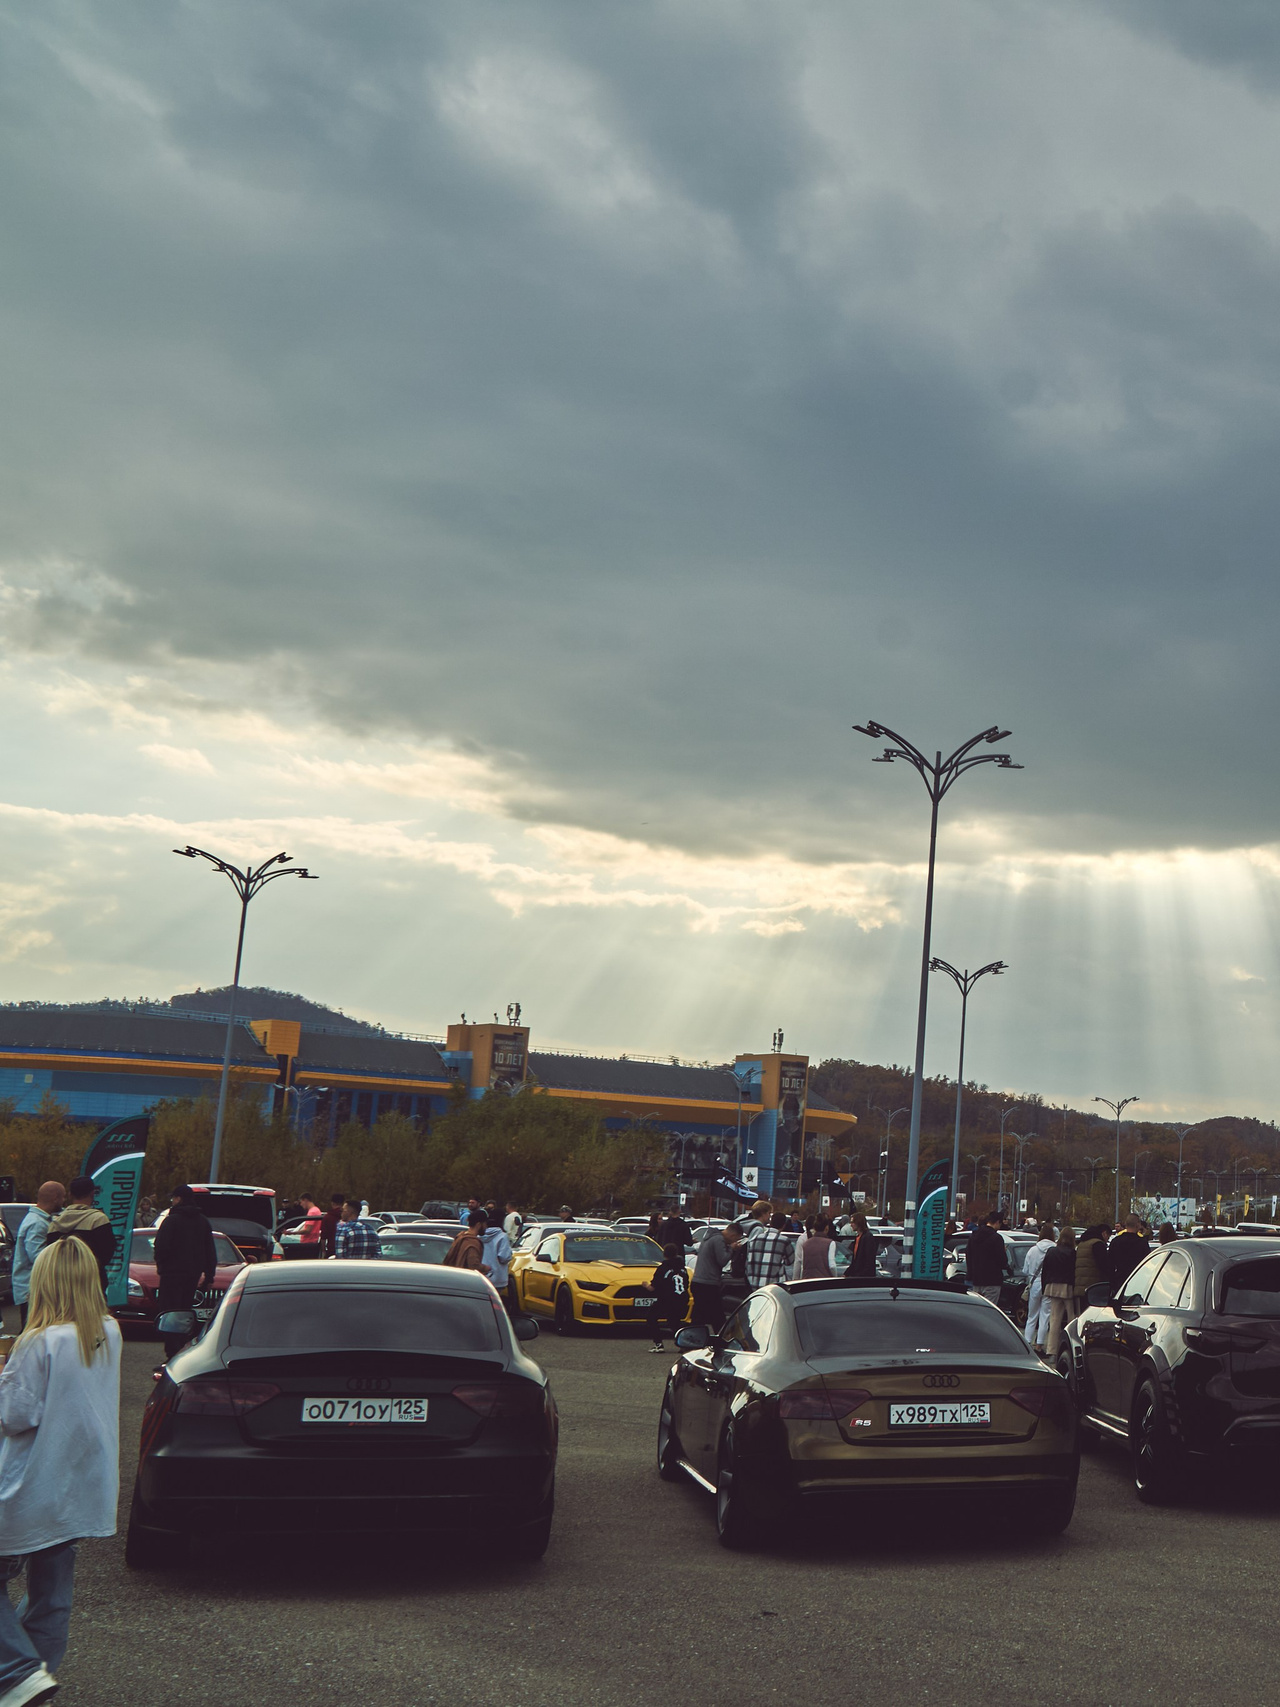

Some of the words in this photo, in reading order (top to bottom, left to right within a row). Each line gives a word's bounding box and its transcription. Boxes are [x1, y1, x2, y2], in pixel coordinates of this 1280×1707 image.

[494, 1051, 505, 1064] 10
[506, 1053, 524, 1066] ЛЕТ
[782, 1077, 790, 1088] 10
[791, 1078, 805, 1089] ЛЕТ
[109, 1171, 136, 1228] ПРОКАТ
[931, 1199, 945, 1241] ПРОКАТ
[394, 1400, 423, 1414] 125
[962, 1404, 986, 1418] 125
